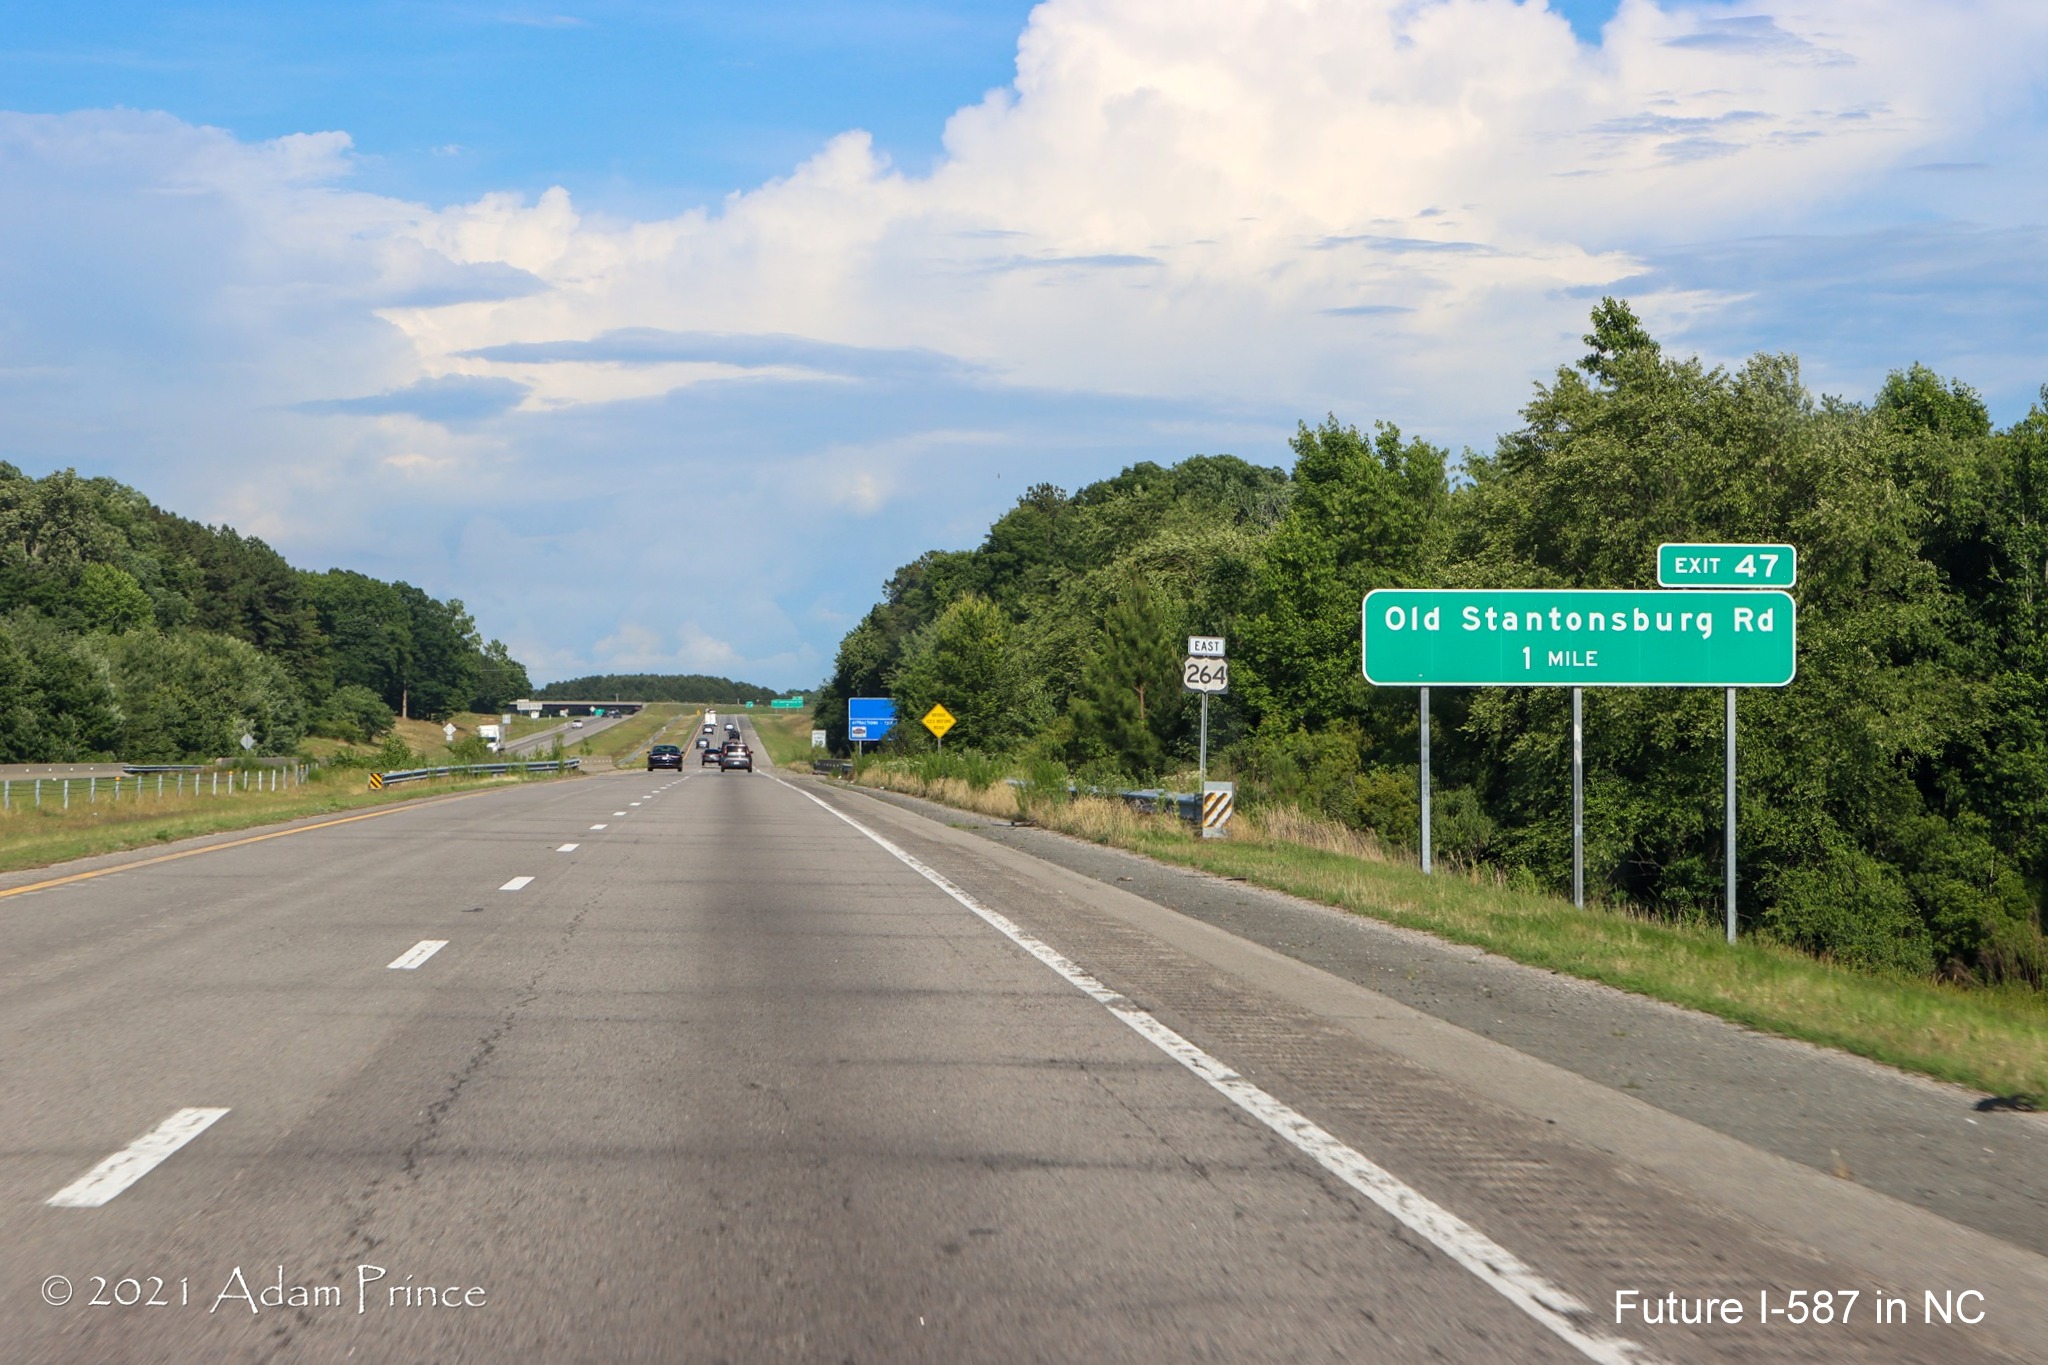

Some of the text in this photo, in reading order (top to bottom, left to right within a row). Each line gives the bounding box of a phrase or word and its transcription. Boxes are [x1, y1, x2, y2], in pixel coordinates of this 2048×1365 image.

[1675, 554, 1779, 578] EXIT 47
[1384, 606, 1774, 639] Old Stantonsburg Rd
[1194, 641, 1220, 652] EAST
[1522, 646, 1598, 670] 1 MILE
[1186, 664, 1226, 685] 264
